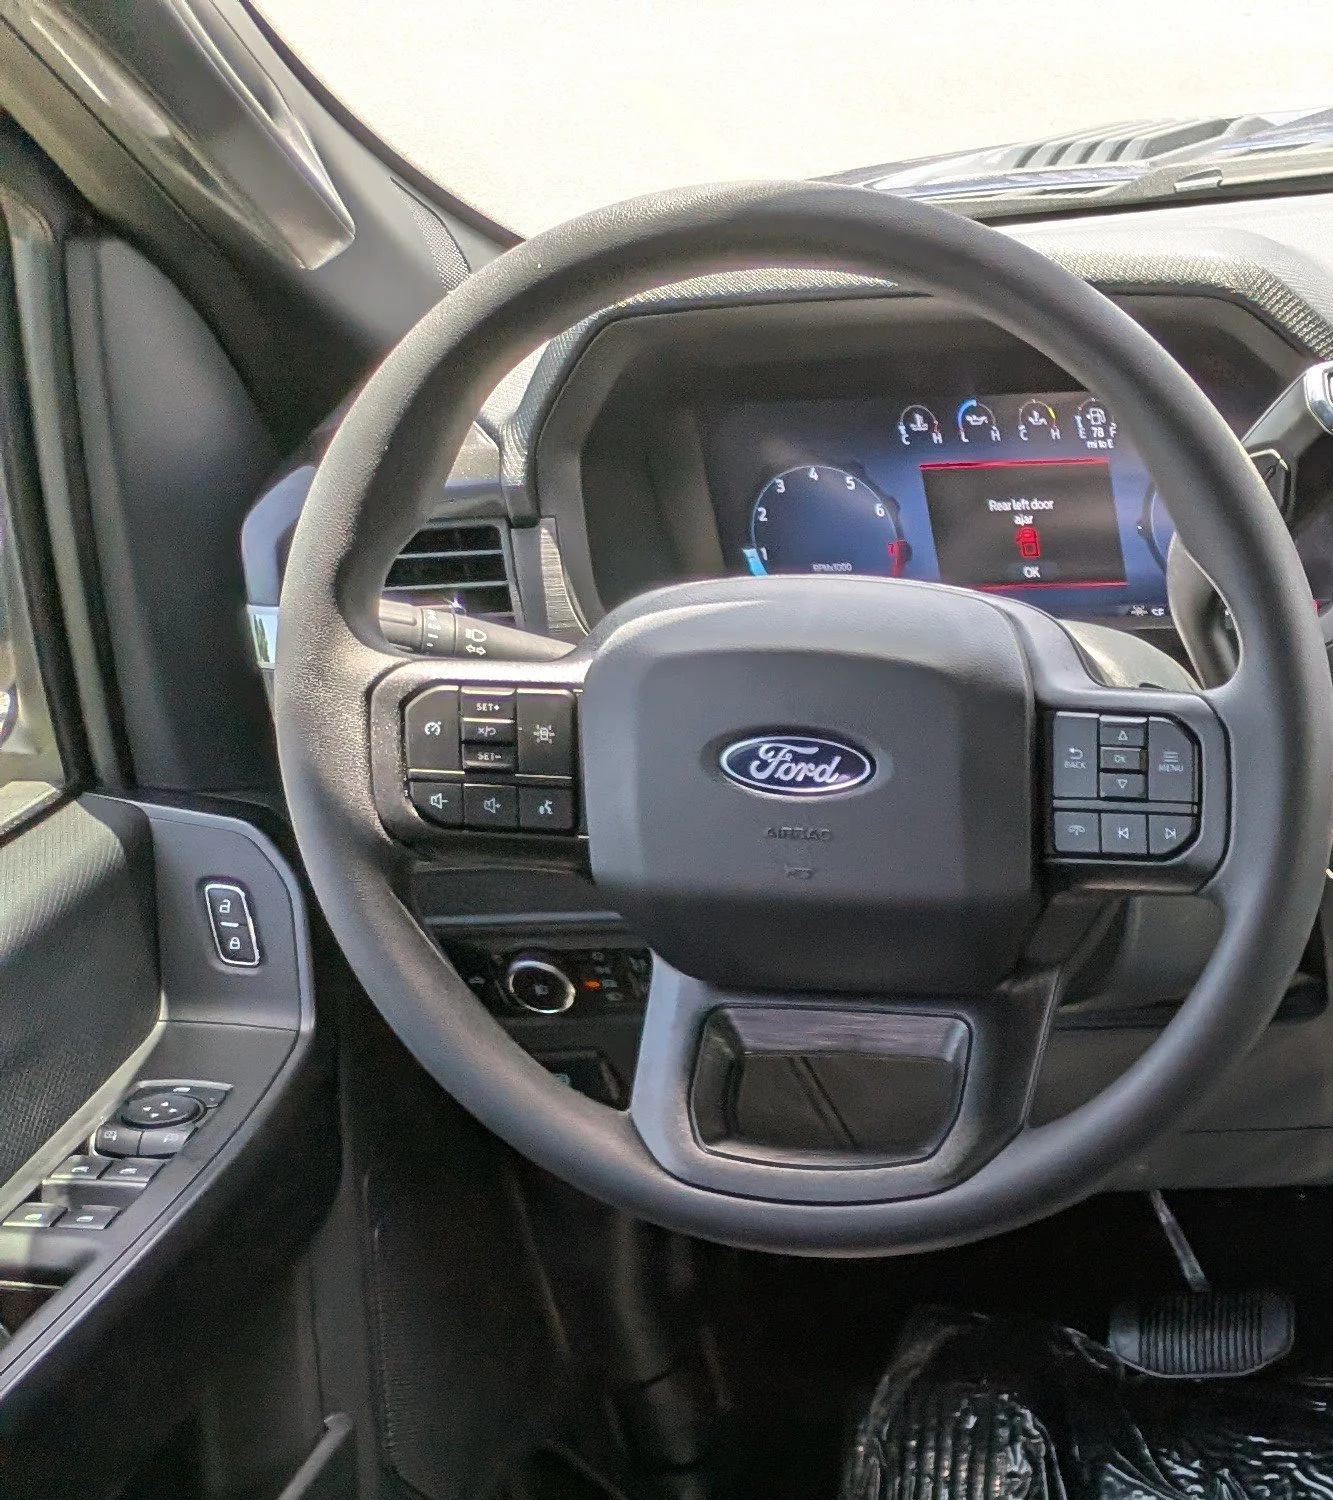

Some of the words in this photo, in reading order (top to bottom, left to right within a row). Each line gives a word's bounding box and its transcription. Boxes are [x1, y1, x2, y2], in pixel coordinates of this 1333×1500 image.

[901, 433, 911, 445] C
[932, 432, 942, 444] H
[960, 431, 970, 442] L
[1019, 429, 1028, 441] C
[1050, 428, 1061, 440] H
[808, 467, 819, 481] 4
[775, 478, 786, 493] 3
[845, 476, 856, 490] 5
[875, 503, 885, 517] 6
[988, 499, 1011, 511] Rear
[1011, 498, 1030, 510] left
[1030, 498, 1054, 510] door
[757, 507, 768, 522] 2
[1013, 514, 1033, 526] ajar
[760, 547, 768, 561] 1
[1023, 566, 1040, 578] OK
[750, 742, 842, 783] Ford
[1064, 761, 1086, 769] BACK
[1158, 764, 1184, 772] MENU
